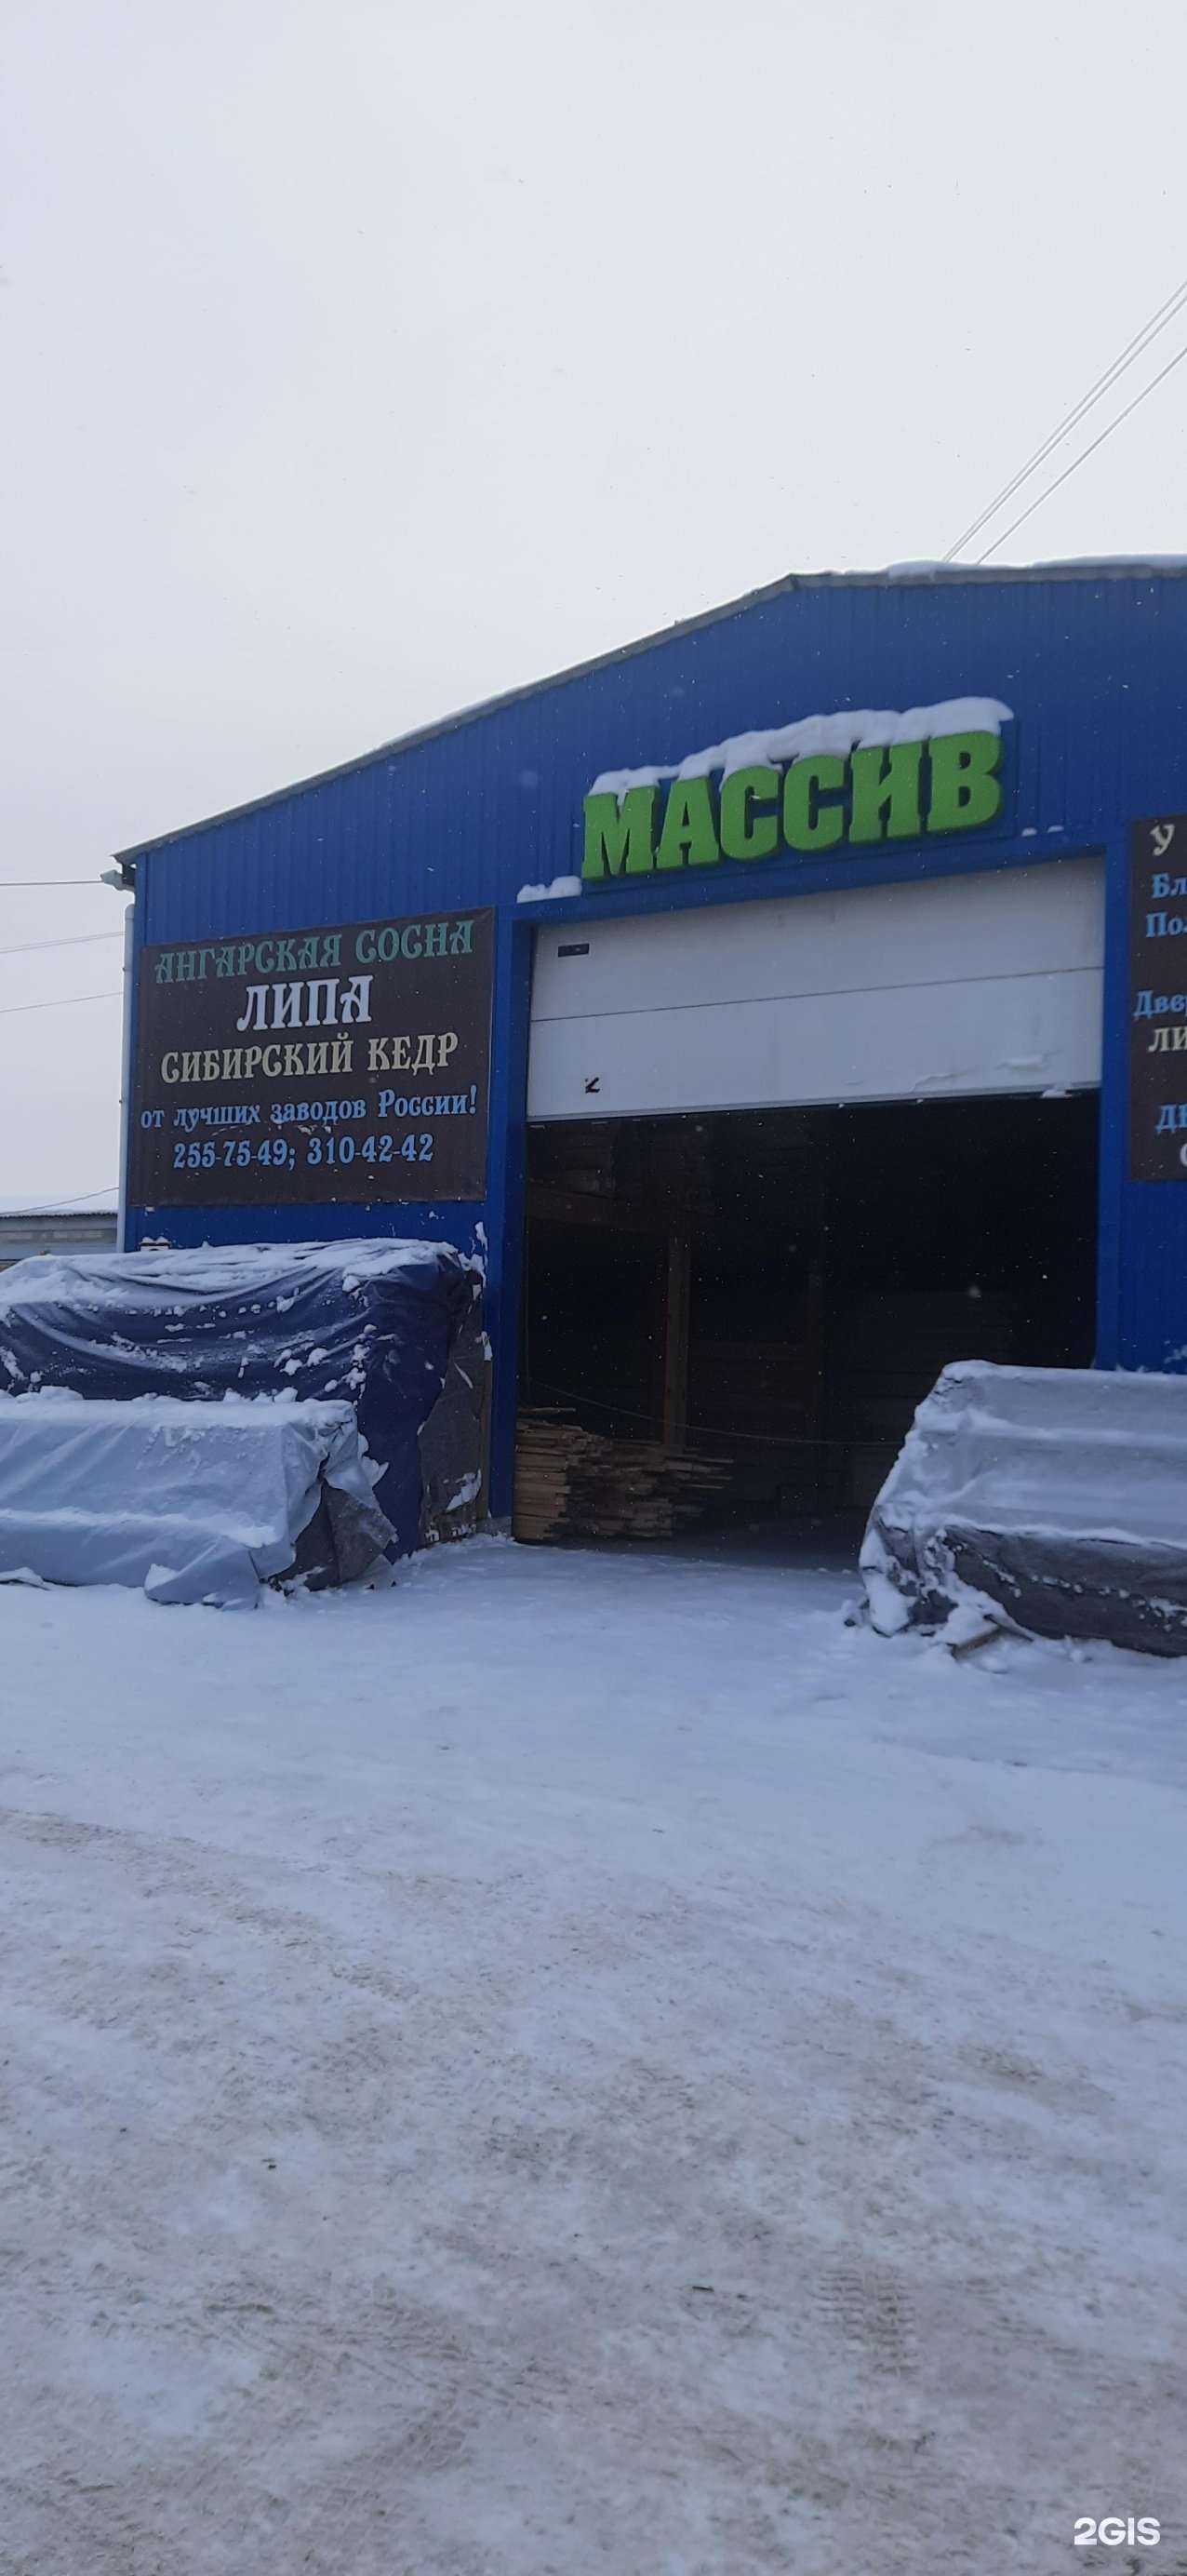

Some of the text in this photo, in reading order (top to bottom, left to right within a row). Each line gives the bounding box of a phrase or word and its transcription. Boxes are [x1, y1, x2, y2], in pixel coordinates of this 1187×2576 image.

[581, 730, 1002, 882] МАССИВ
[1150, 824, 1176, 856] У
[154, 919, 474, 984] АНГАРСКАЯ СОСНА
[236, 974, 374, 1032] ЛИПА
[160, 1031, 460, 1084] СИБИРСКИЙ КЕДР
[140, 1084, 478, 1133] от лучших заводов России!
[173, 1133, 434, 1170] 255-75-49; 310-42-42
